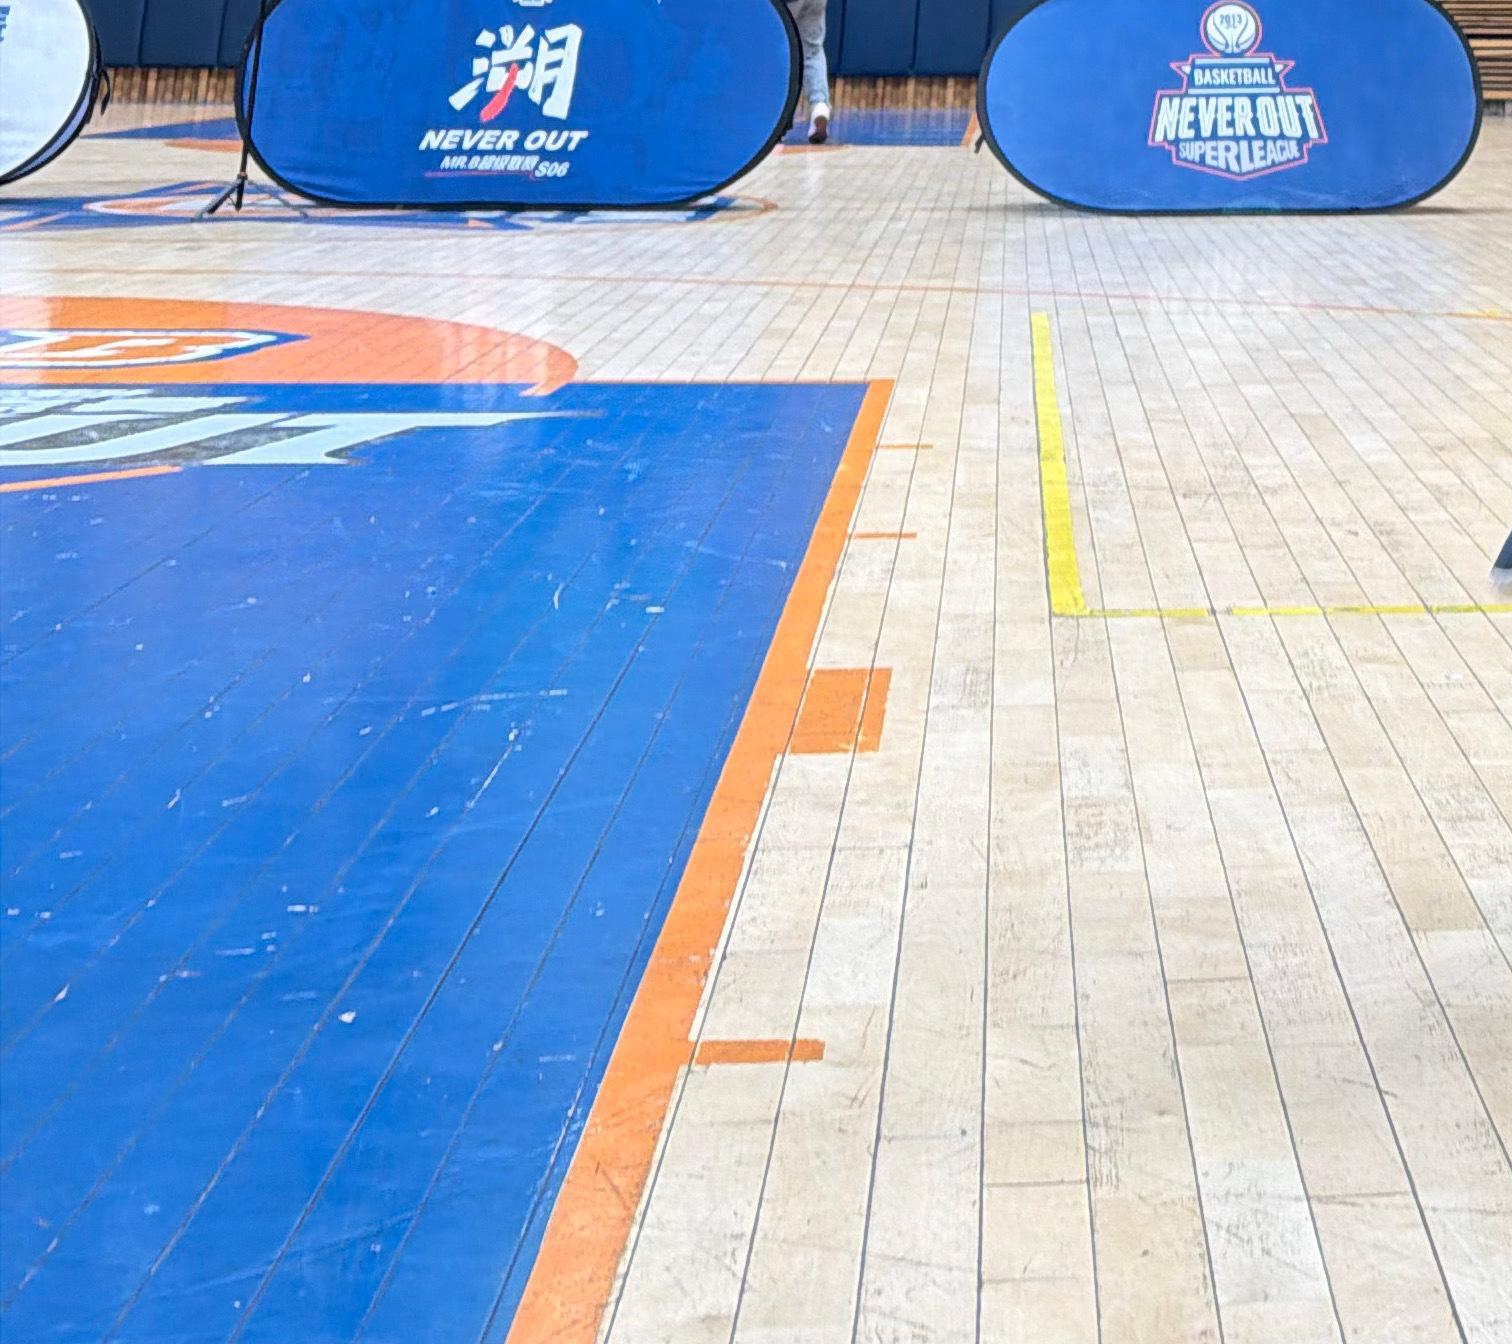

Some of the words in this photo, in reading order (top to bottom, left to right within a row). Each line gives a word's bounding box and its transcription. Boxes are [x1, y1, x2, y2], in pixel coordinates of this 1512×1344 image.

[448, 23, 582, 123] 溯
[1193, 67, 1276, 86] BASKETBALL
[1154, 96, 1256, 142] NEVER
[1255, 95, 1319, 139] OUT
[418, 129, 520, 151] NEVER
[523, 130, 589, 152] OUT
